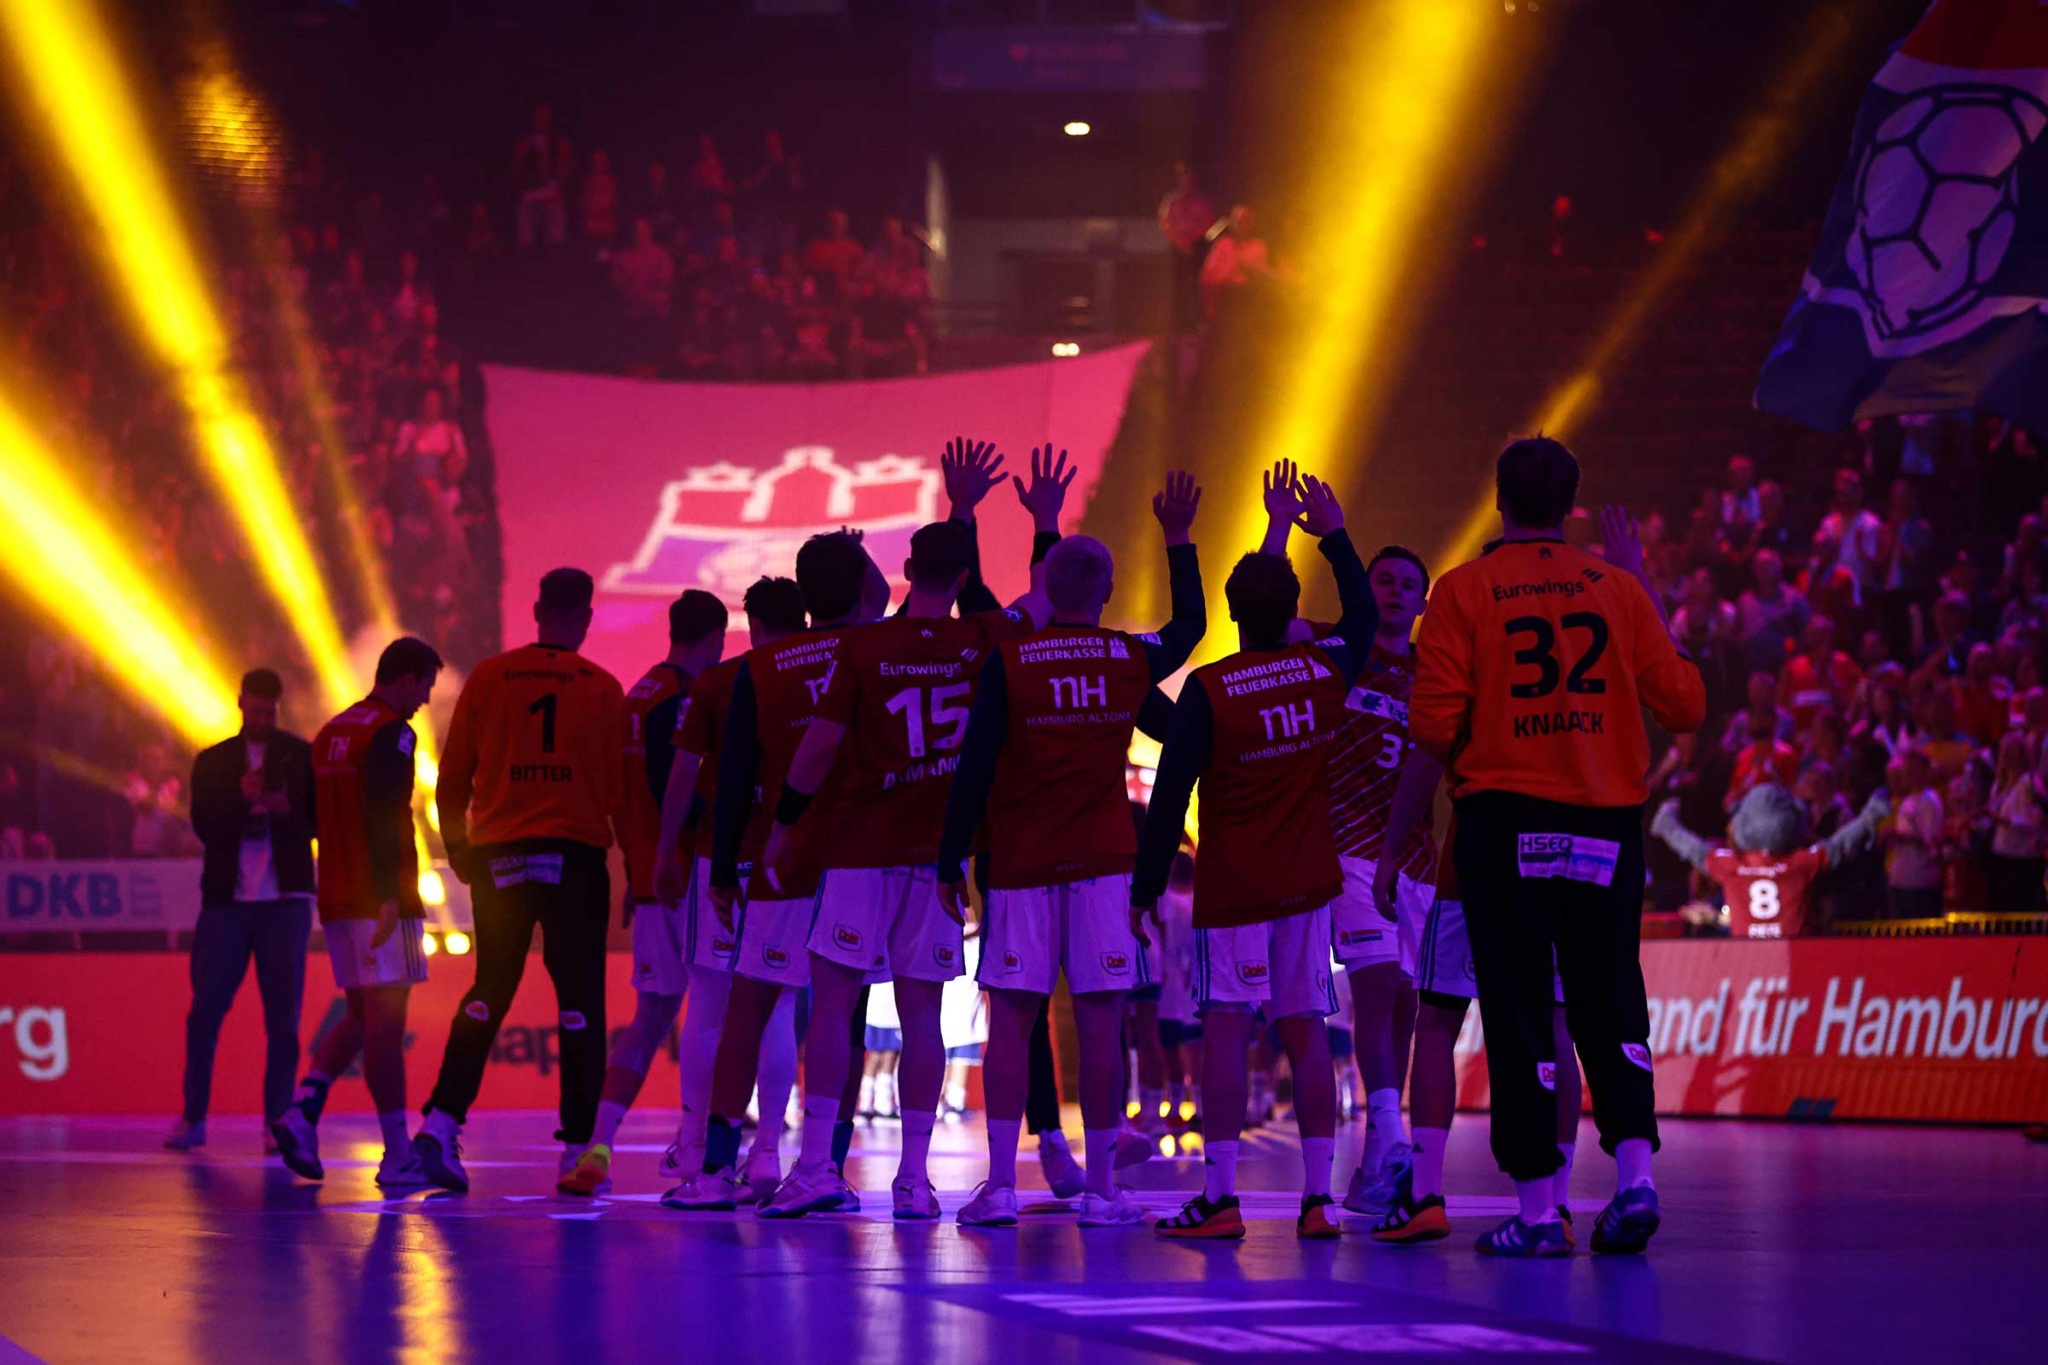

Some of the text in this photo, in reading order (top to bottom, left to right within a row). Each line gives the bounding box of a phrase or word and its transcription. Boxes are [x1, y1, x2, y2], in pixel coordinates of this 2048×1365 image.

[1493, 580, 1585, 601] Eurowings
[774, 637, 840, 661] HAMBURG
[1019, 637, 1105, 653] HAMBURGER
[1020, 648, 1107, 664] FEUERKASSE
[1504, 612, 1609, 698] 32
[776, 650, 835, 672] FEUERKA
[880, 661, 962, 678] Eurowings
[1222, 657, 1306, 685] HAMBURGER
[1226, 669, 1311, 697] FEUERKASSE
[528, 694, 557, 752] 1
[885, 680, 971, 758] 15
[1026, 713, 1085, 726] HAMBURG
[1239, 742, 1298, 763] HAMBURG
[511, 765, 572, 782] BITTER
[7, 873, 124, 918] DKB
[1748, 879, 1780, 920] 8
[1107, 956, 1126, 966] Dole
[1243, 964, 1268, 976] Dole
[1733, 975, 1811, 1057] für
